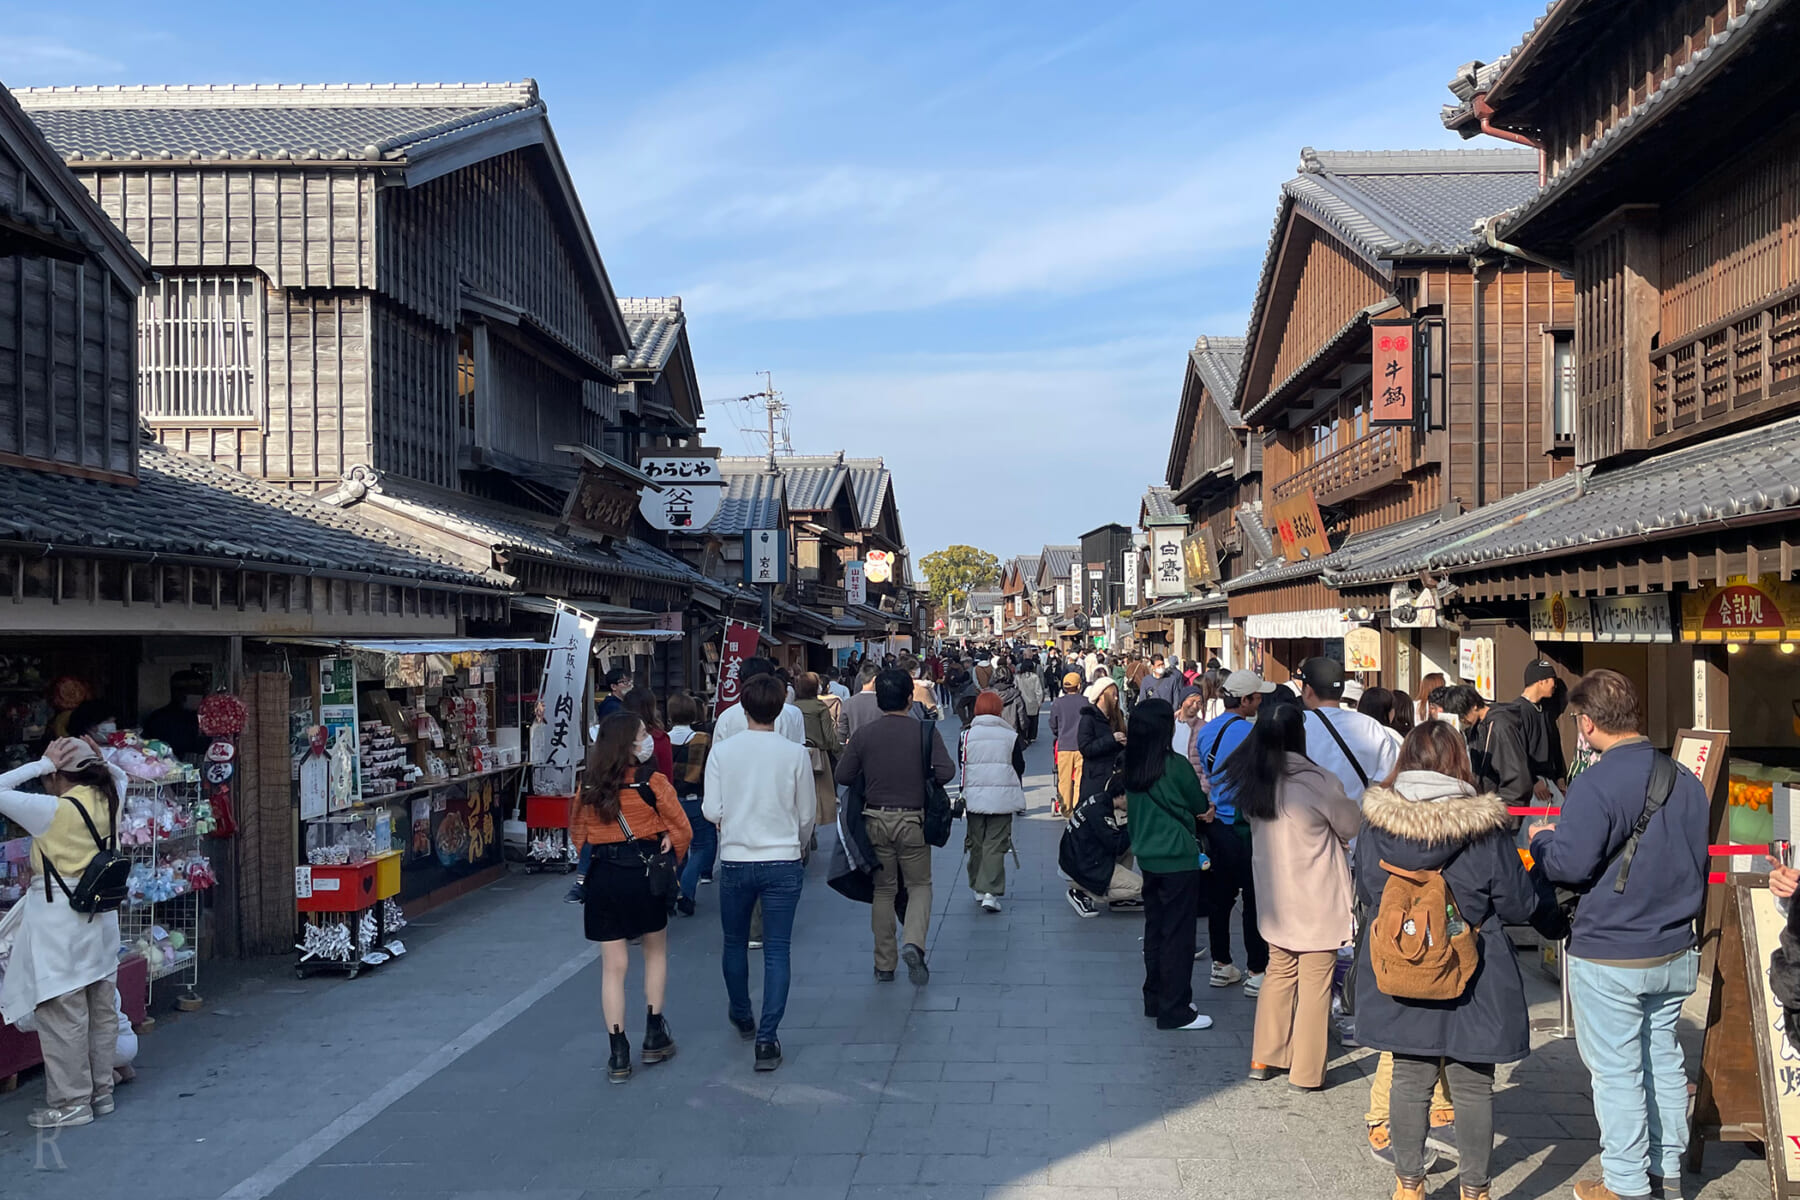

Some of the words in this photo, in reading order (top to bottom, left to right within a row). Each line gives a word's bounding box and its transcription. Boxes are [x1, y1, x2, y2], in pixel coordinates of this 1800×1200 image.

[1382, 359, 1406, 407] 牛鍋
[644, 461, 712, 478] わらじや
[759, 556, 771, 579] 岩座
[1157, 541, 1182, 582] 白鷹
[1719, 594, 1763, 626] 会計処
[564, 634, 579, 686] 松阪牛
